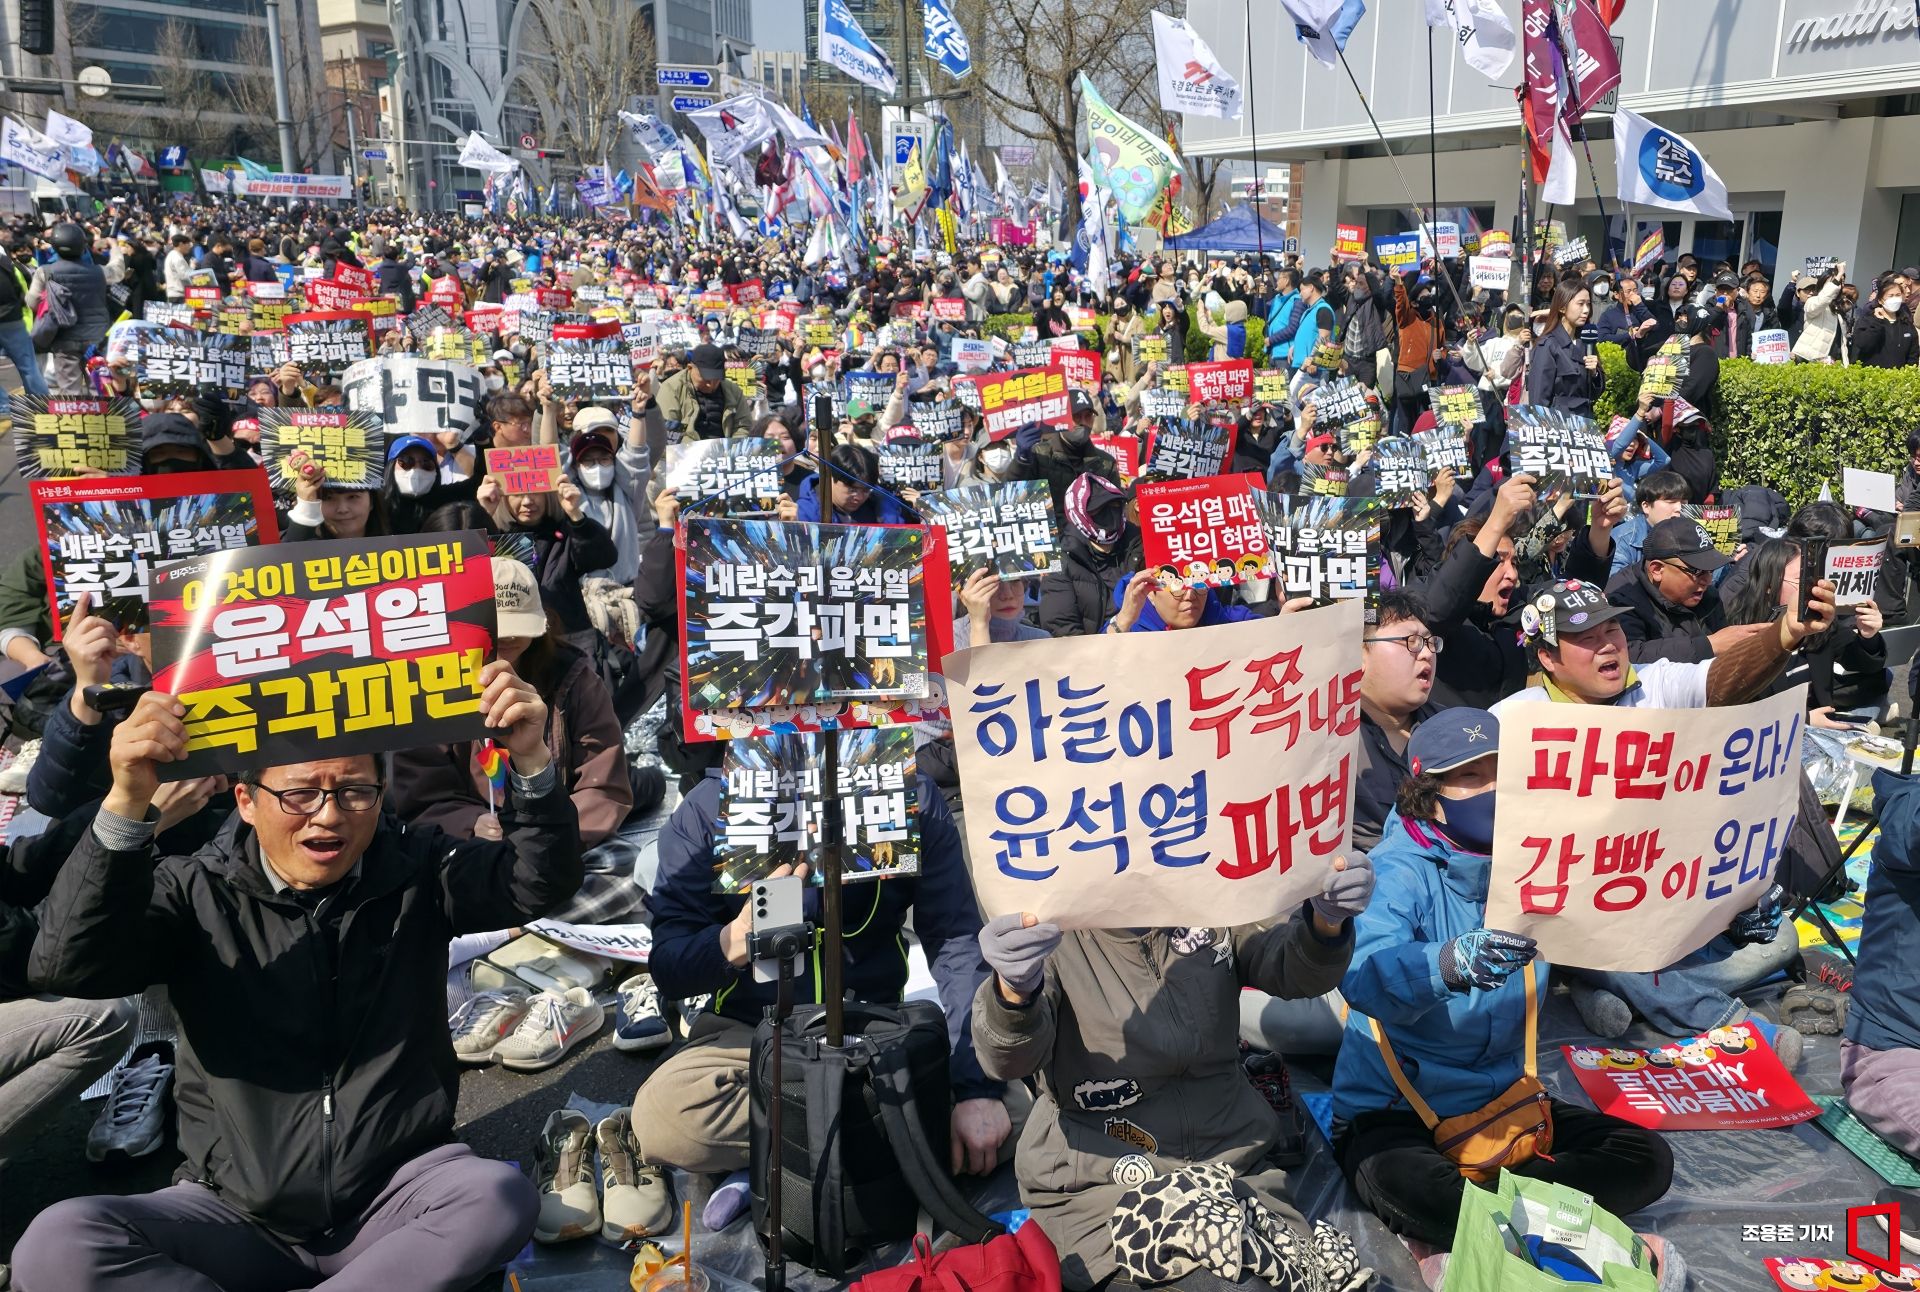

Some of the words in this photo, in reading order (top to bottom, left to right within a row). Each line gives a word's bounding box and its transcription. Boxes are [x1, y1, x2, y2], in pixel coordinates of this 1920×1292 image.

[1786, 0, 1918, 43] matthe
[1656, 159, 1692, 184] 뉴스
[1377, 242, 1417, 256] 내란수괴
[291, 332, 331, 345] 내란수괴
[332, 331, 363, 343] 윤석열
[624, 326, 640, 338] 수괴
[145, 343, 205, 361] 내란수괴
[207, 350, 247, 365] 윤석열
[291, 342, 366, 363] 즉각파면
[551, 352, 595, 366] 내란수괴
[597, 353, 629, 365] 윤석열
[1059, 356, 1095, 370] 새봄에는
[145, 358, 246, 389] 즉각파면
[550, 364, 633, 387] 즉각파면
[1193, 371, 1228, 388] 윤석열
[1228, 368, 1250, 383] 파면
[982, 372, 1064, 411] 윤석열을
[1200, 385, 1223, 401] 빛의
[1224, 383, 1245, 398] 혁명
[54, 402, 100, 413] 내란수괴
[297, 414, 340, 425] 내란수괴
[986, 395, 1069, 433] 파면하라!
[1316, 394, 1367, 423] 즉각파면
[1162, 434, 1205, 452] 내란수괴
[1203, 442, 1224, 458] 윤석열
[1442, 437, 1465, 449] 윤석열
[1519, 426, 1573, 444] 내란수괴
[1572, 430, 1605, 450] 윤석열
[488, 447, 558, 473] 윤석열
[735, 455, 778, 471] 윤석열
[879, 455, 915, 467] 내란수괴
[915, 454, 940, 465] 윤석열
[1155, 448, 1222, 479] 즉각파면
[1380, 457, 1414, 471] 내란수괴
[1426, 448, 1468, 470] 각파면
[1519, 445, 1613, 480] 즉각파면
[504, 470, 551, 494] 파면
[677, 472, 781, 500] 즉각파면
[880, 464, 941, 484] 즉각파면
[74, 485, 143, 496] www.nanum.com
[930, 506, 998, 532] 내란수괴
[1000, 501, 1048, 523] 윤석열
[1151, 495, 1226, 533] 윤석열
[1707, 510, 1729, 518] 내란수괴
[59, 531, 164, 560] 내란수괴
[167, 523, 248, 553] 윤석열
[947, 520, 1054, 565] 즉각파면
[1167, 528, 1218, 563] 빛의
[1221, 522, 1265, 555] 혁명
[1297, 527, 1368, 554] 윤석열
[183, 562, 296, 612] 이것이
[304, 542, 464, 593] 민심이다!
[705, 564, 825, 597] 내란수괴
[829, 565, 910, 599] 윤석열
[1283, 555, 1368, 599] 파면
[211, 581, 451, 679] 윤석열
[704, 600, 912, 661] 즉각파면
[178, 647, 486, 754] 즉각파면
[969, 675, 1175, 764] 하늘이
[1526, 727, 1712, 801] 파면이
[1718, 712, 1800, 796] 온다!
[728, 768, 822, 799] 내란수괴
[988, 769, 1212, 881] 윤석열
[1216, 752, 1352, 880] 파면
[1514, 828, 1703, 916] 감빵이
[1704, 814, 1797, 901] 온다!
[1606, 1062, 1749, 1093] 새나라로
[1626, 1087, 1771, 1116] 새봄에는
[1556, 1210, 1584, 1226] GREEN
[1558, 1200, 1584, 1217] THINK
